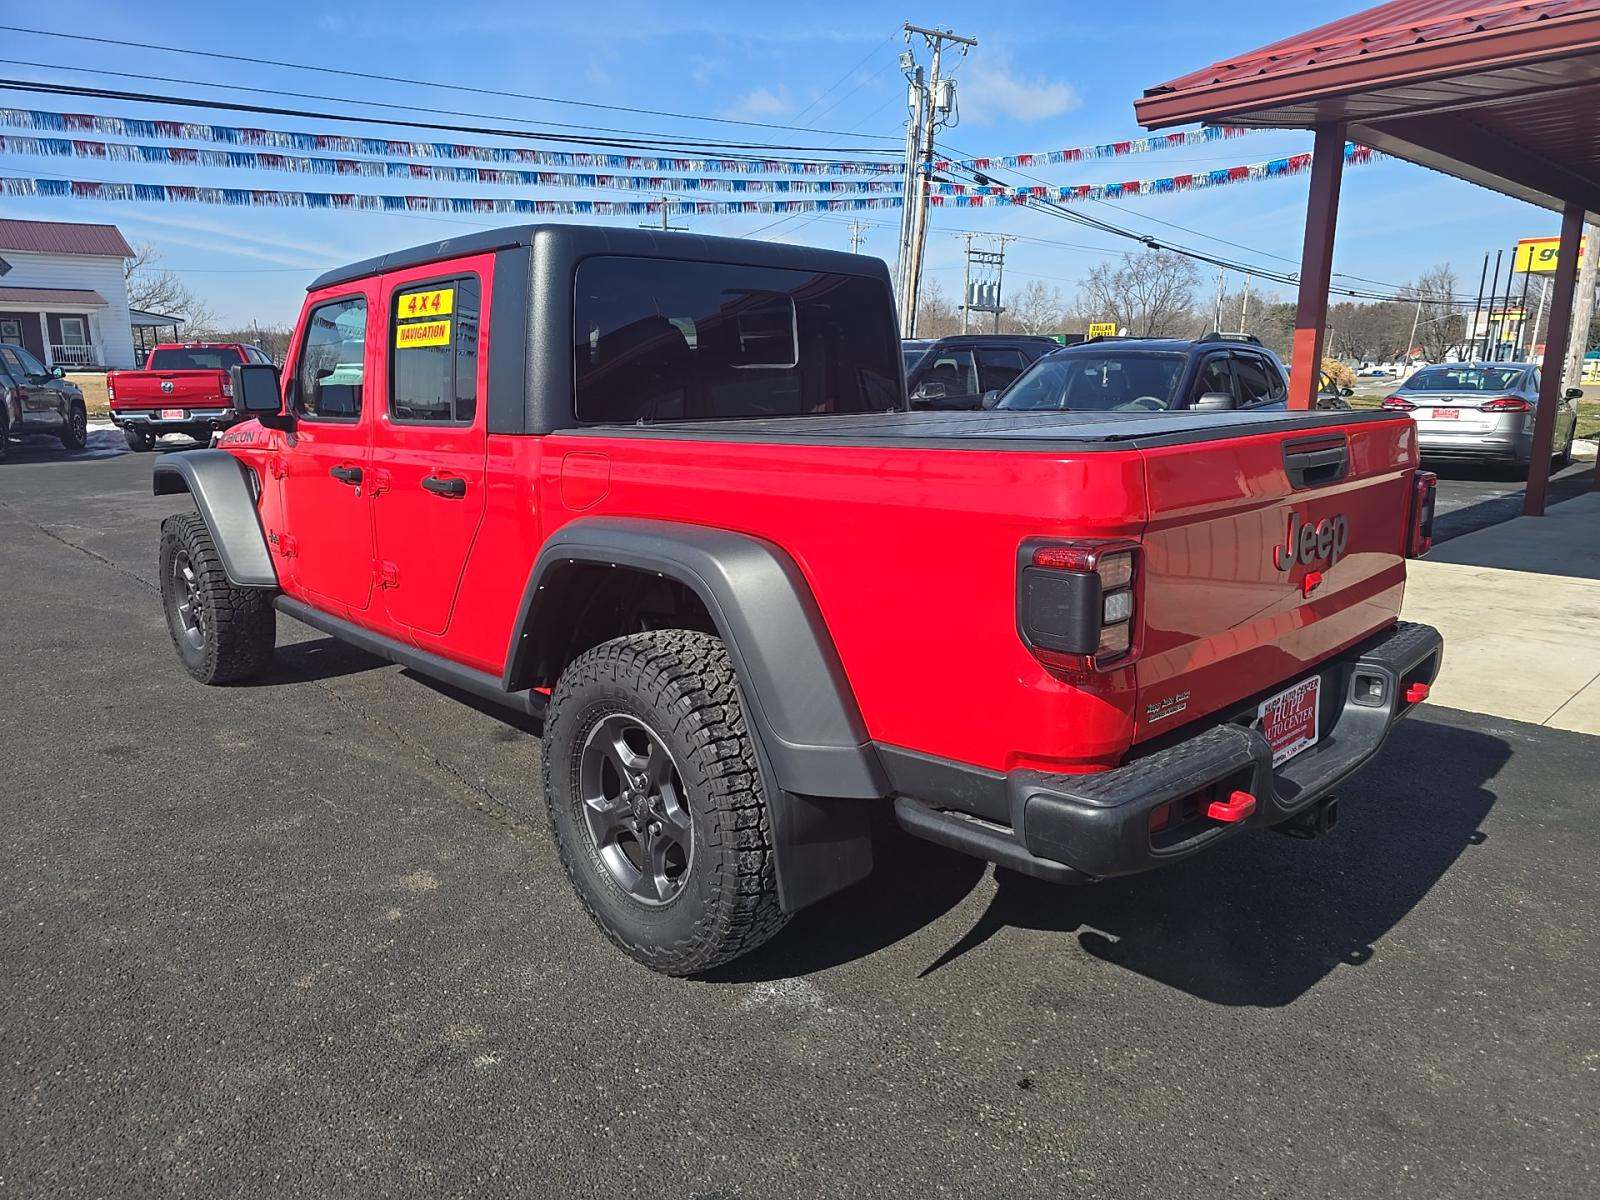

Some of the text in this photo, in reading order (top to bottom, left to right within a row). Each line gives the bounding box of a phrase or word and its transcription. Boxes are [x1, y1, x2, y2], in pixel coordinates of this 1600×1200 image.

[400, 324, 446, 341] NAVIGATION
[1273, 512, 1349, 571] Jeep
[1296, 679, 1319, 697] CENTER
[1272, 693, 1304, 726] HUPP
[1283, 706, 1314, 731] CENTER
